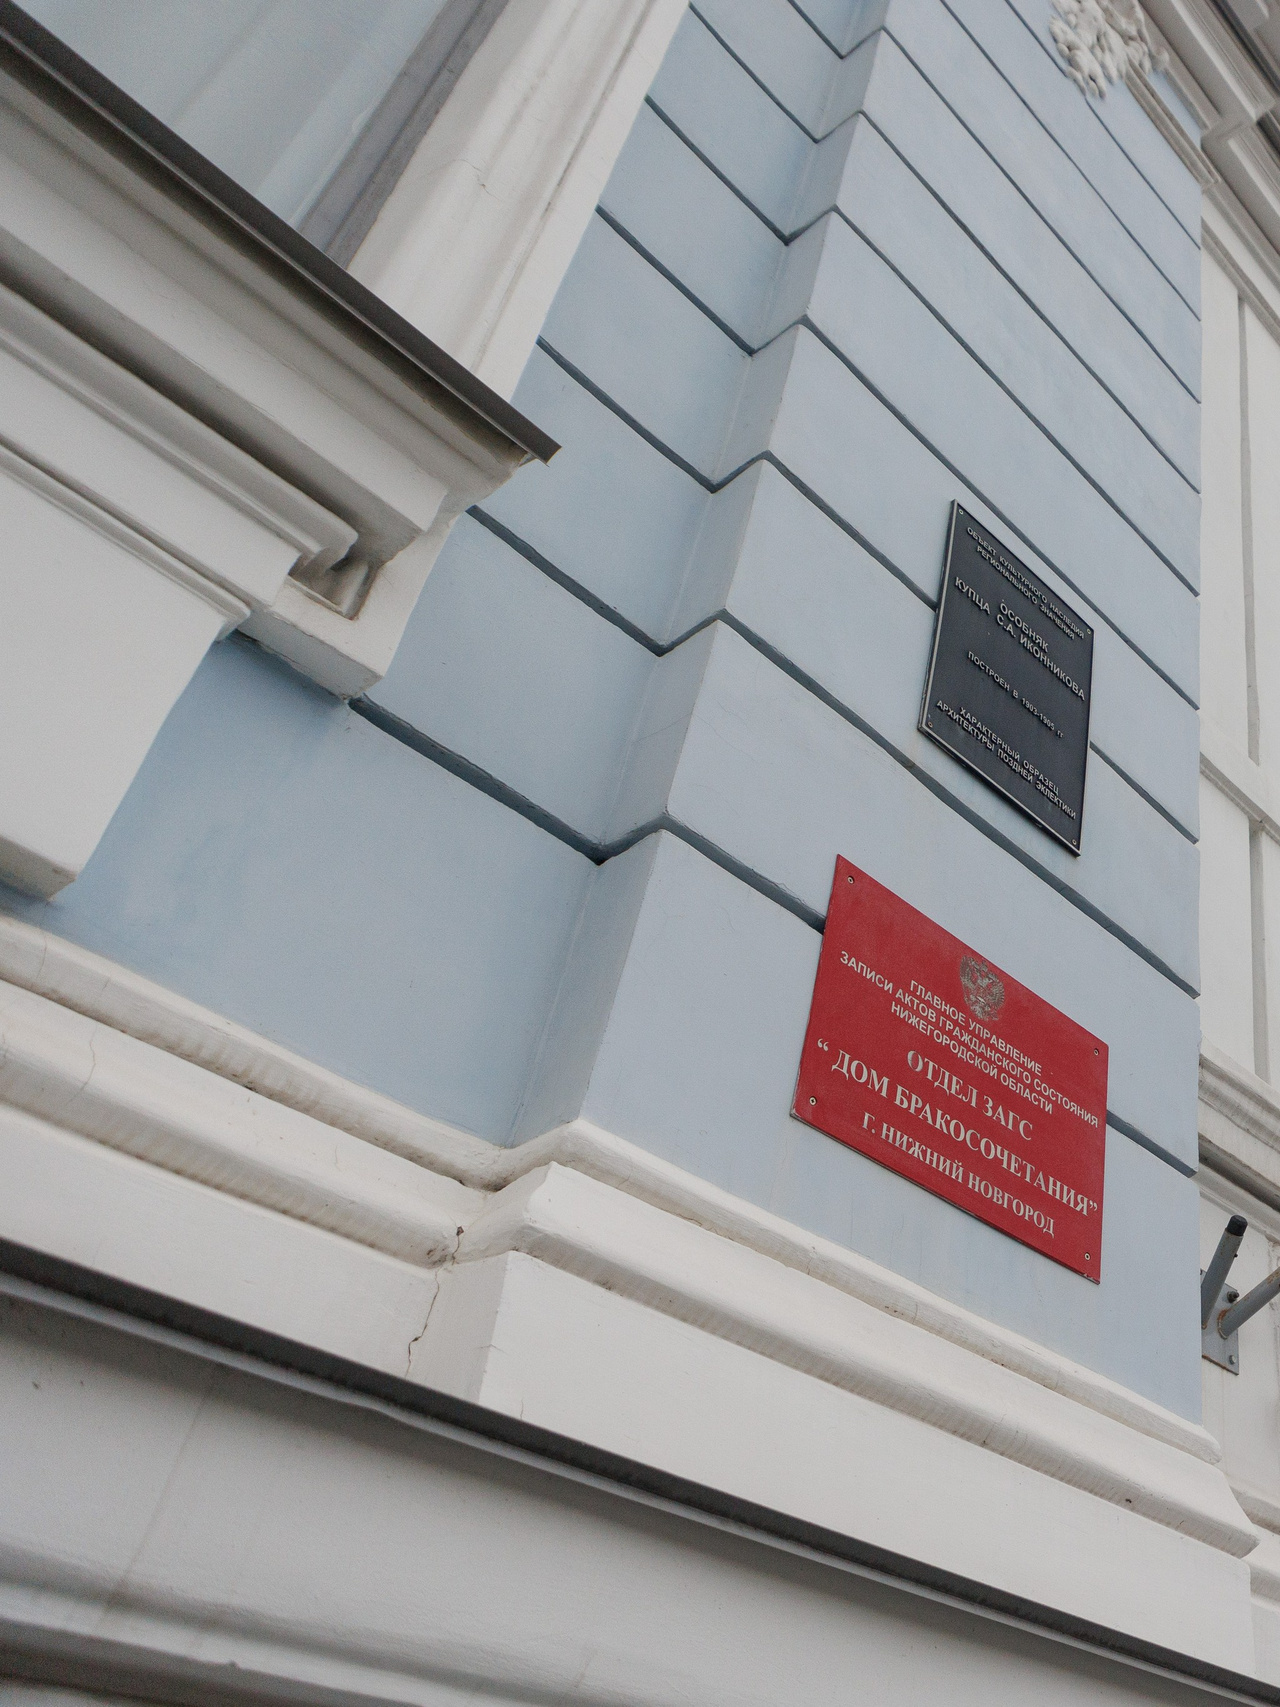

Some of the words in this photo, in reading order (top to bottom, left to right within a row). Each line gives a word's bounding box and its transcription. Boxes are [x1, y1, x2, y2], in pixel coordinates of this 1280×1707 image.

[966, 526, 997, 556] ОБЪЕКТ
[999, 555, 1048, 603] КУЛЬТУРНОГО
[1049, 603, 1085, 639] НАСЛЕДИЯ
[977, 545, 1038, 604] РЕГИОНАЛЬНОГО
[1040, 604, 1075, 640] ЗНАЧЕНИЯ
[999, 602, 1049, 653] ОСОБНЯК
[955, 576, 991, 615] КУПЦА
[996, 614, 1017, 638] С.А.
[1019, 633, 1085, 701] ИКОННИКОВА
[968, 651, 1010, 692] ПОСТРОЕН
[1012, 689, 1019, 699] В
[1022, 698, 1055, 731] 1903-1905
[936, 699, 995, 753] АРХИТЕКТУРЫ
[997, 749, 1034, 784] ПОЗДНЕЙ
[1035, 781, 1076, 820] ЭКЛЕКТИКИ
[960, 707, 1020, 762] ХАРАКТЕРНЫЙ
[1023, 760, 1059, 795] ОБРАЗЕЦ
[840, 950, 894, 994] ЗАПИСИ
[895, 989, 936, 1023] АКТОВ
[939, 1017, 1031, 1084] ГРАЖДАНСКОГО
[1033, 1079, 1099, 1128] СОСТОЯНИЯ
[891, 1001, 998, 1080] НИЖЕГОРОДСКОЙ
[1000, 1072, 1053, 1115] ОБЛАСТИ
[910, 979, 966, 1026] ГЛАВНОЕ
[968, 1018, 1042, 1076] УПРАВЛЕНИЕ
[907, 1050, 978, 1109] ОТДЕЛ
[982, 1095, 1033, 1141] ЗАГС
[881, 1122, 964, 1184] НИЖНИЙ
[968, 1170, 1055, 1239] НОВГОРОД
